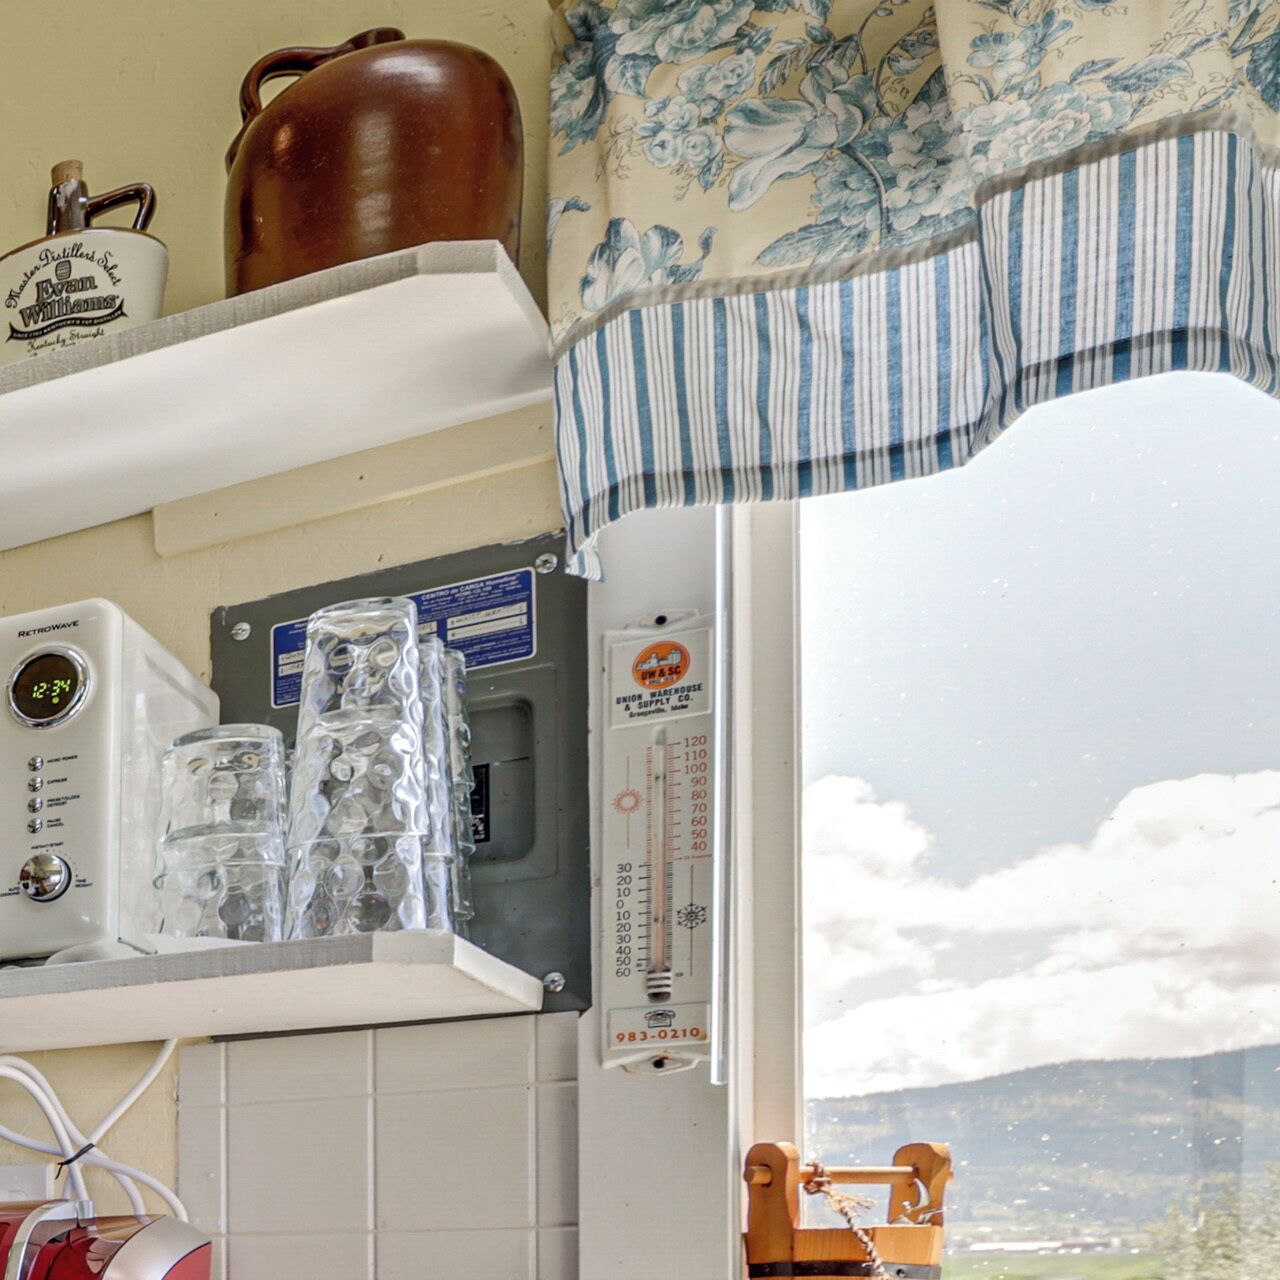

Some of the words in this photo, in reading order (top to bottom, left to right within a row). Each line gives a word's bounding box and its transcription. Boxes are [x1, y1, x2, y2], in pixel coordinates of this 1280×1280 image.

[5, 264, 42, 309] Master
[97, 250, 122, 287] Select
[36, 275, 98, 303] Evan
[19, 295, 117, 328] Williams
[27, 335, 67, 352] Kentucky
[69, 327, 104, 341] Straight
[641, 670, 656, 681] UW
[658, 669, 666, 677] &
[669, 665, 682, 675] SC
[32, 679, 72, 699] 12:34
[616, 693, 643, 705] UNION
[650, 683, 703, 699] WAREHOUSE
[624, 704, 631, 712] &
[638, 697, 671, 709] SUPPLY
[678, 694, 693, 702] CO.
[684, 735, 707, 748] 120
[684, 749, 707, 762] 110
[684, 762, 707, 775] 100
[691, 776, 707, 788] 90
[691, 789, 707, 801] 80
[691, 802, 707, 814] 70
[691, 815, 707, 827] 60
[691, 828, 707, 840] 50
[691, 841, 707, 852] 40
[616, 863, 632, 874] 30
[616, 875, 632, 886] 20
[617, 887, 631, 898] 10
[616, 899, 624, 909] 0
[616, 910, 631, 921] 10
[616, 922, 631, 933] 20
[616, 934, 631, 944] 30
[616, 945, 631, 956] 40
[616, 956, 631, 966] 50
[616, 967, 631, 978] 60
[616, 1027, 700, 1042] 983-0210
